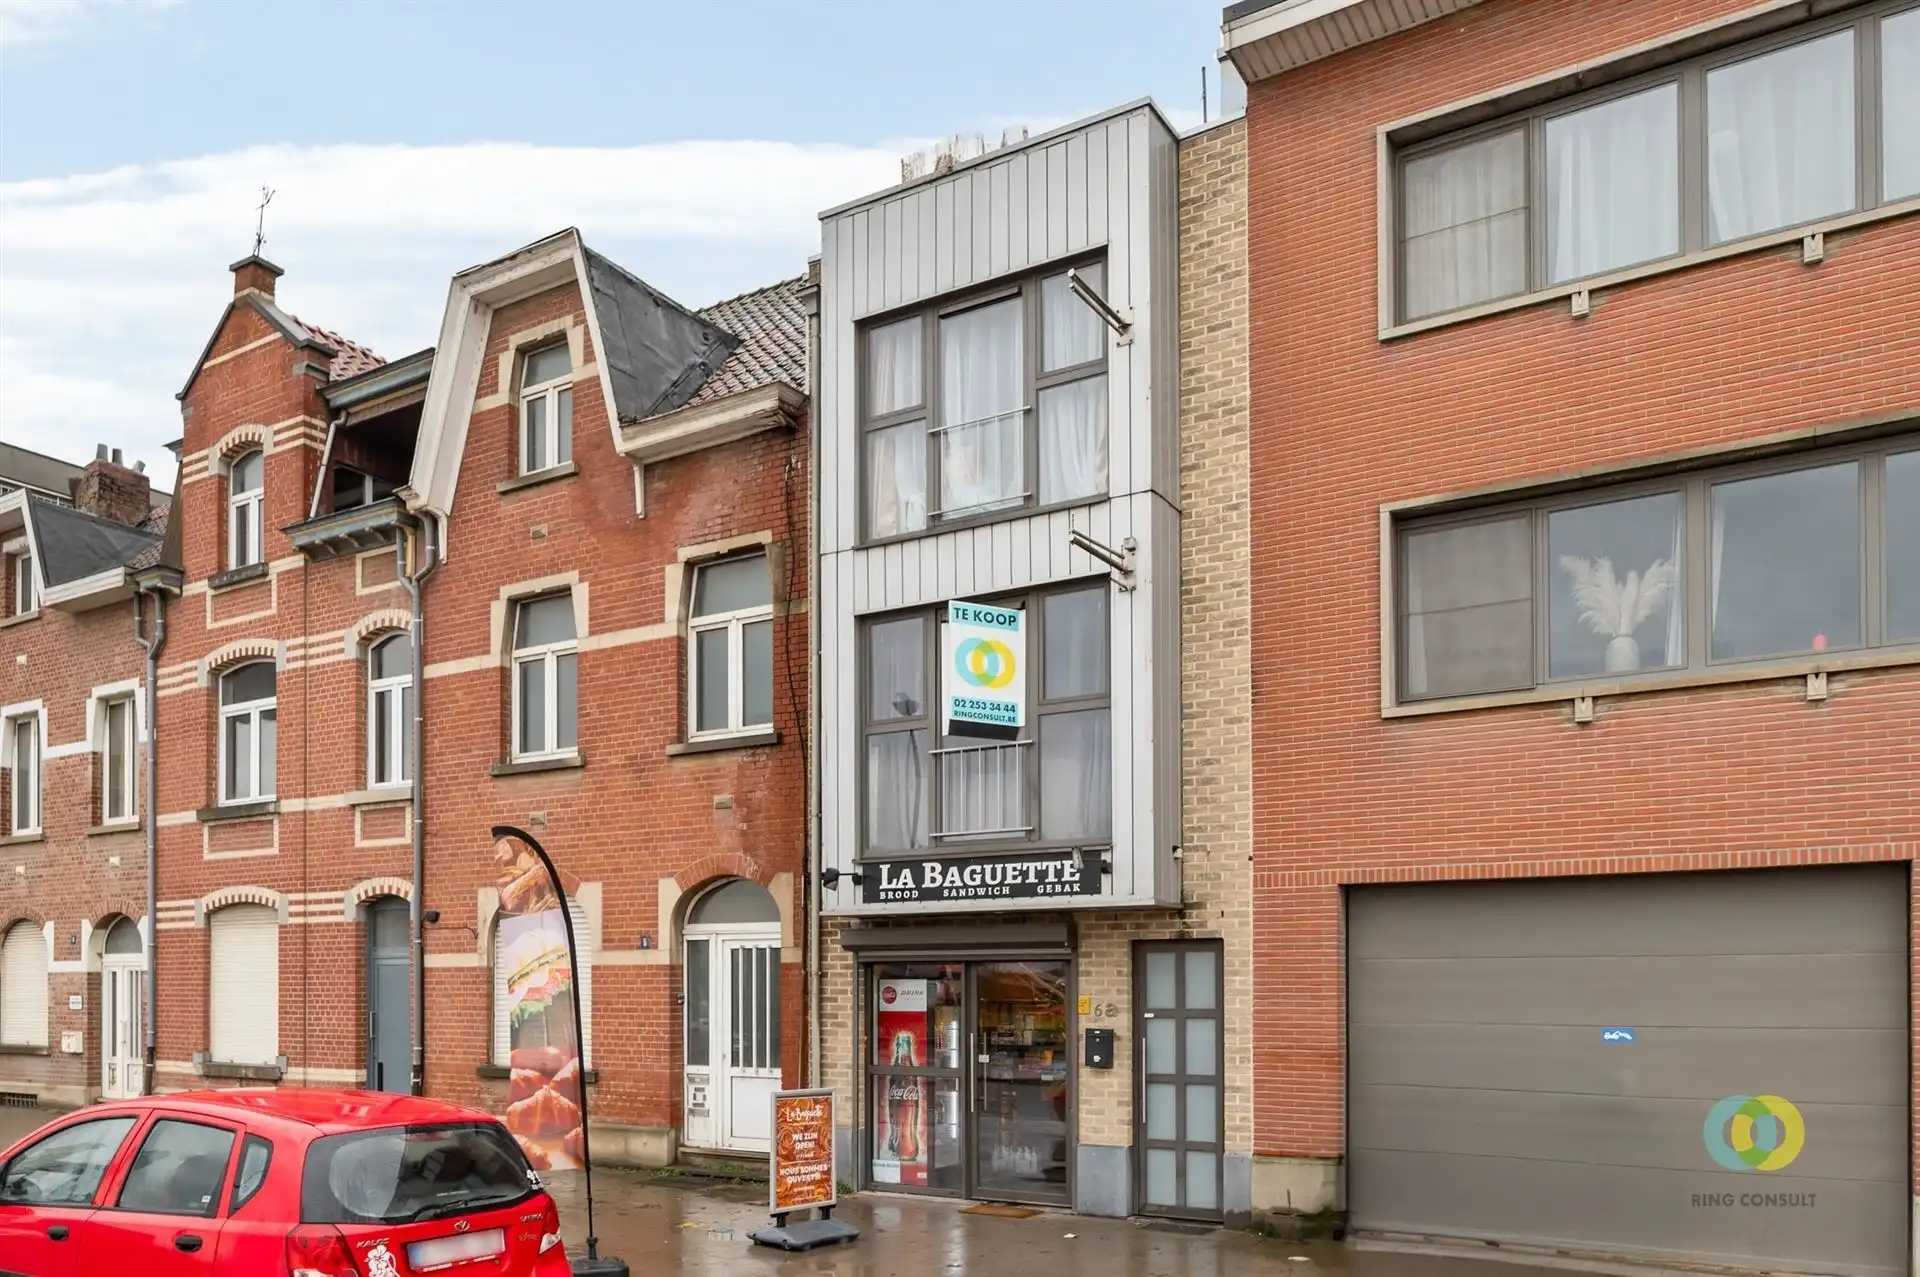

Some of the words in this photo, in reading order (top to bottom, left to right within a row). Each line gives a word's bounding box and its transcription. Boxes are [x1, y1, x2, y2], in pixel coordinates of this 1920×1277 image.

[954, 607, 968, 620] TE
[973, 610, 1017, 626] KOOP
[954, 699, 967, 708] 02
[969, 701, 987, 710] 253
[989, 703, 1001, 711] 34
[1003, 704, 1016, 713] 44
[954, 710, 1016, 723] RINGCONSULT.BE
[879, 864, 916, 889] LA
[922, 860, 1081, 888] BAGUETTE
[880, 890, 919, 899] BROOD
[943, 886, 1010, 897] SANDWICH
[1037, 883, 1081, 894] GEBAK
[791, 1133, 803, 1141] WE
